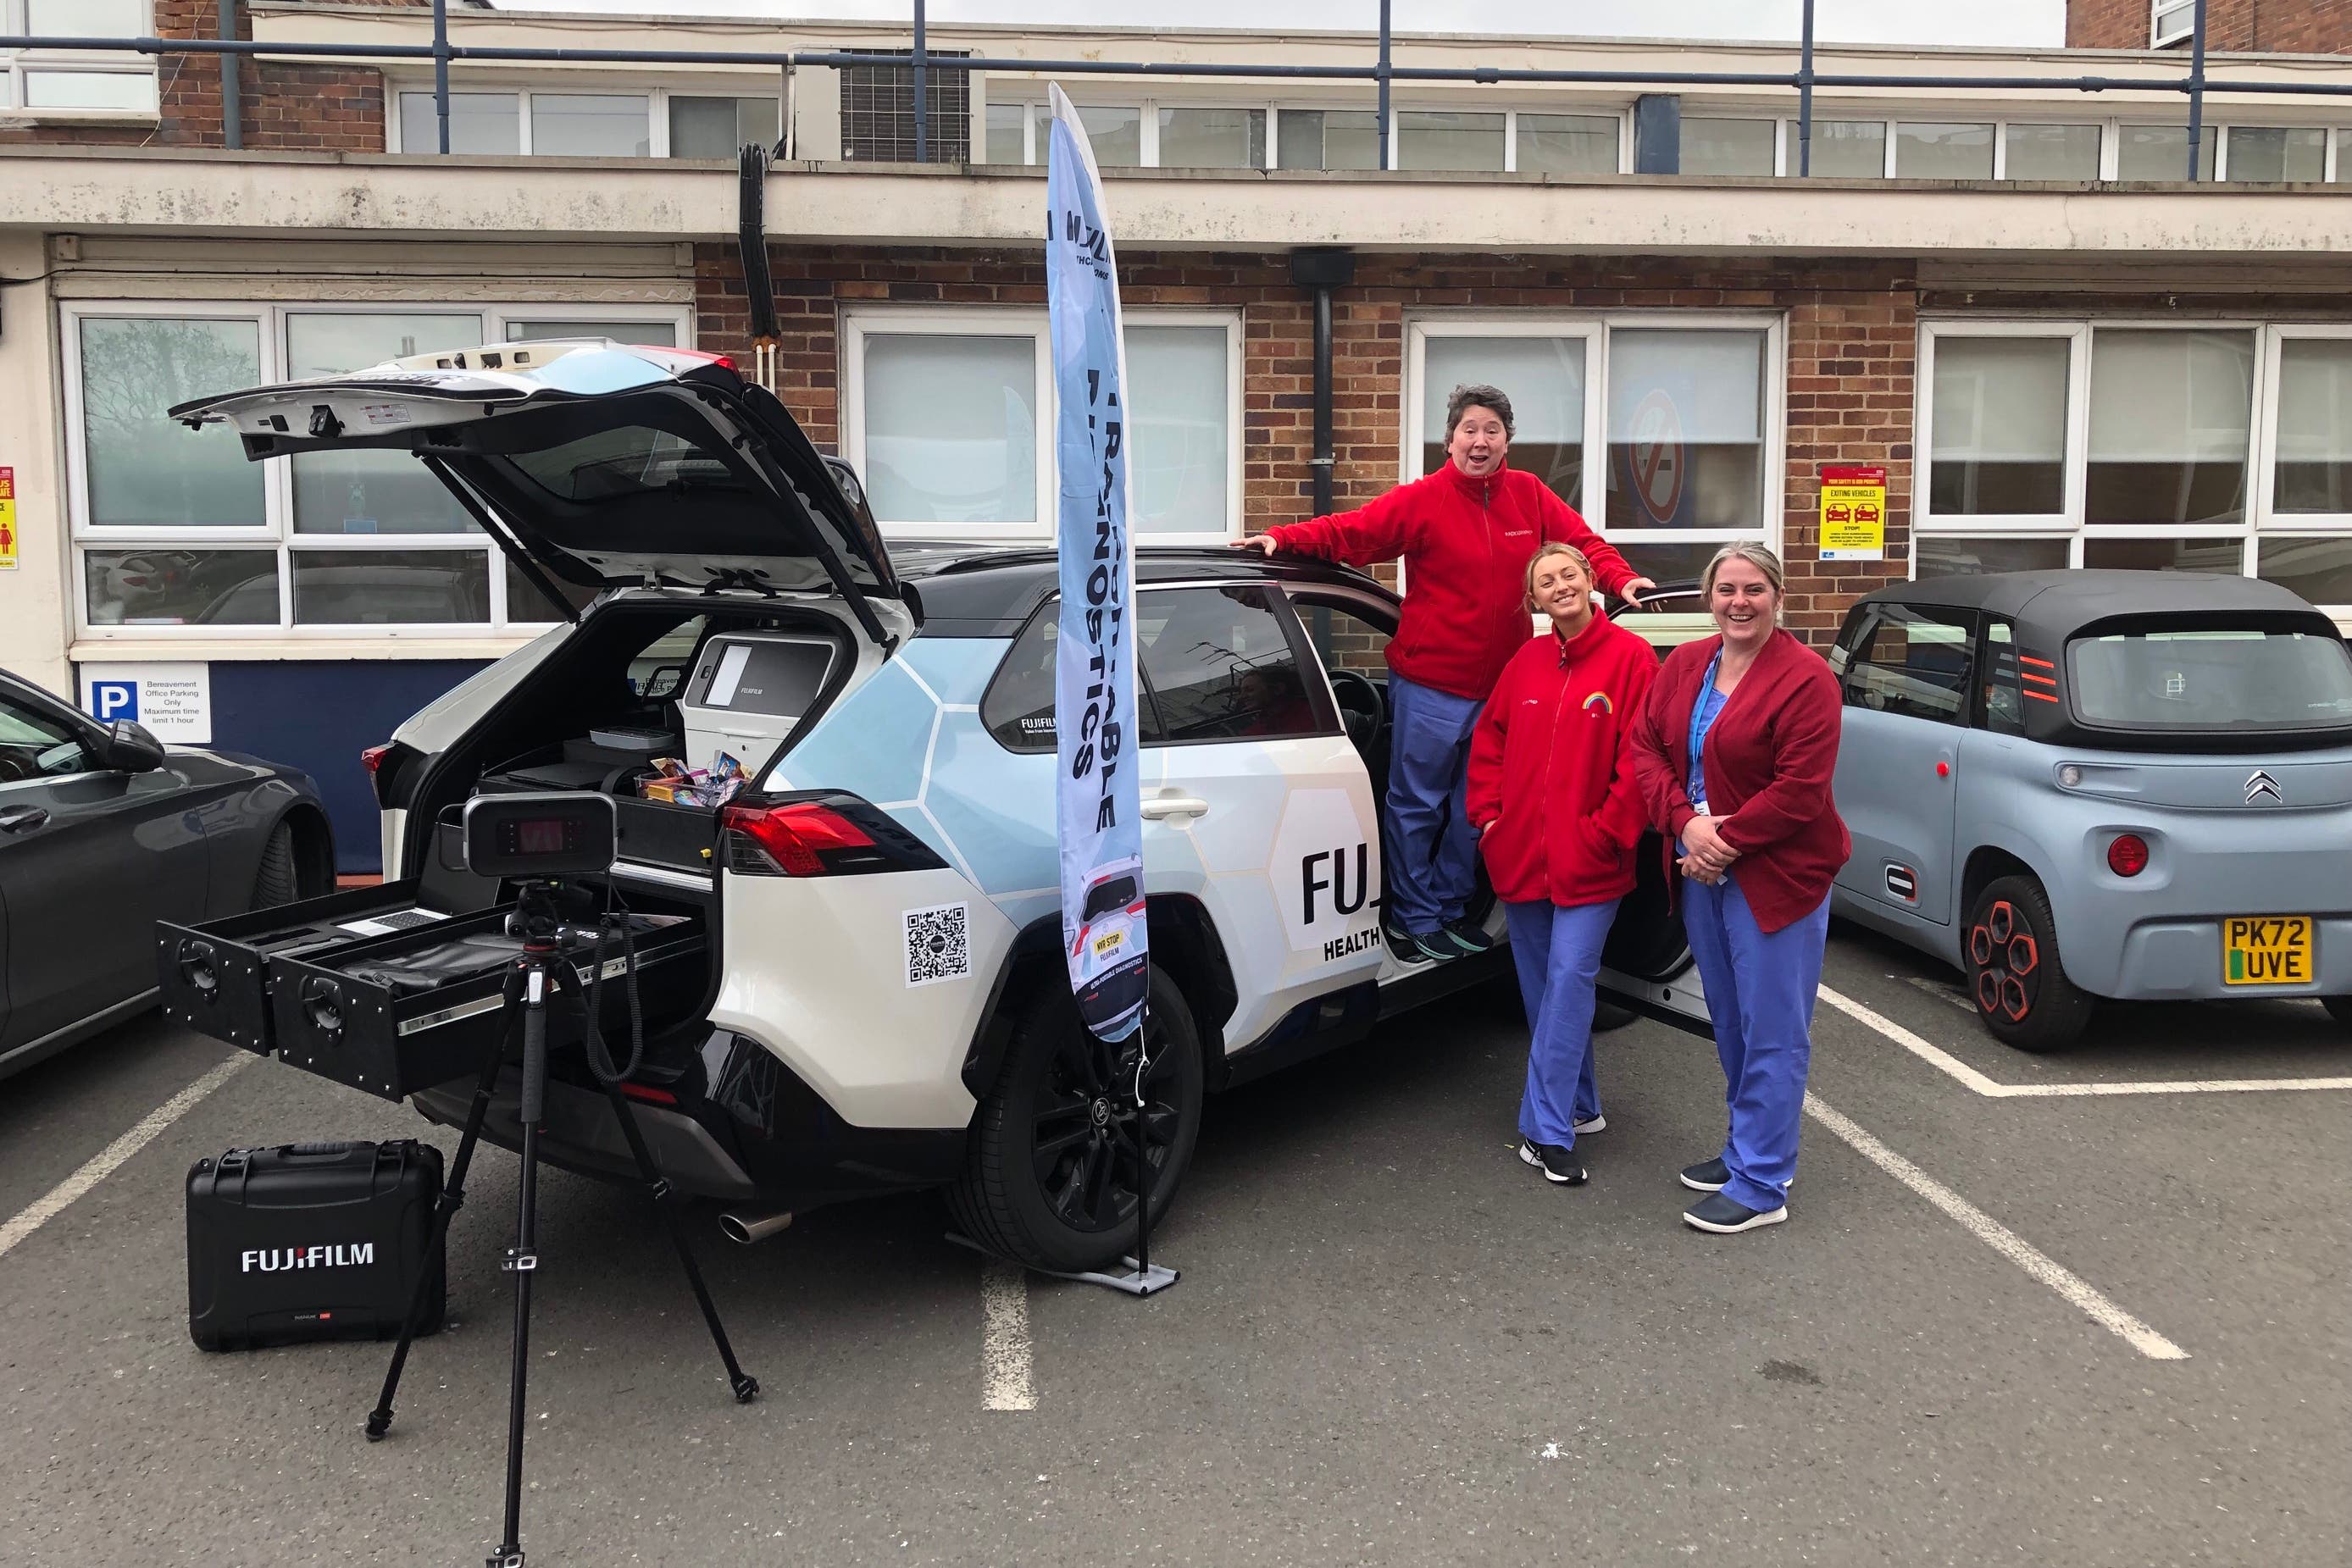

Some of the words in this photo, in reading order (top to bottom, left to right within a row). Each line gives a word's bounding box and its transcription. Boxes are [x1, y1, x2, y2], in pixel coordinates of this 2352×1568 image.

[100, 686, 129, 718] P
[1302, 843, 1380, 925] FU
[1107, 934, 1119, 946] STOP
[1323, 926, 1380, 961] HEALTH
[2232, 920, 2305, 947] PK72
[1100, 947, 1119, 961] FUJIFILM
[1115, 956, 1143, 973] DIAGNOSTICS
[2248, 951, 2302, 978] UVE
[241, 1243, 374, 1272] FUJIFILM
